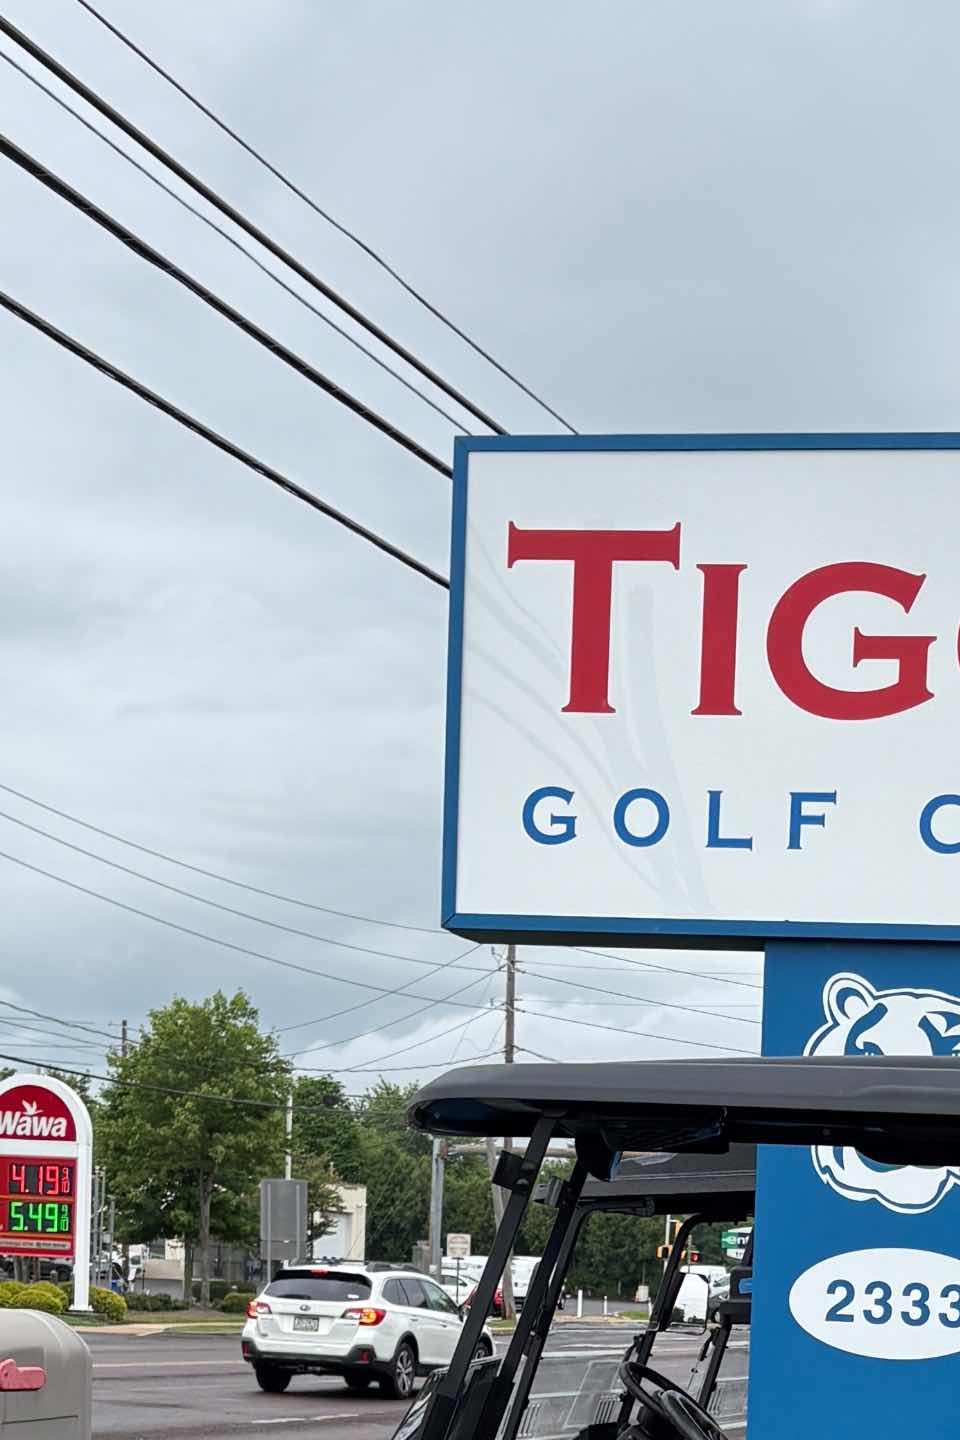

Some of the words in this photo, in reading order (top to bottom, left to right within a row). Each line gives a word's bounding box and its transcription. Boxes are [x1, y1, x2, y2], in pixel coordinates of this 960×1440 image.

[521, 786, 838, 852] GOLF
[0, 1110, 68, 1138] Wawa
[10, 1201, 59, 1232] 5.49
